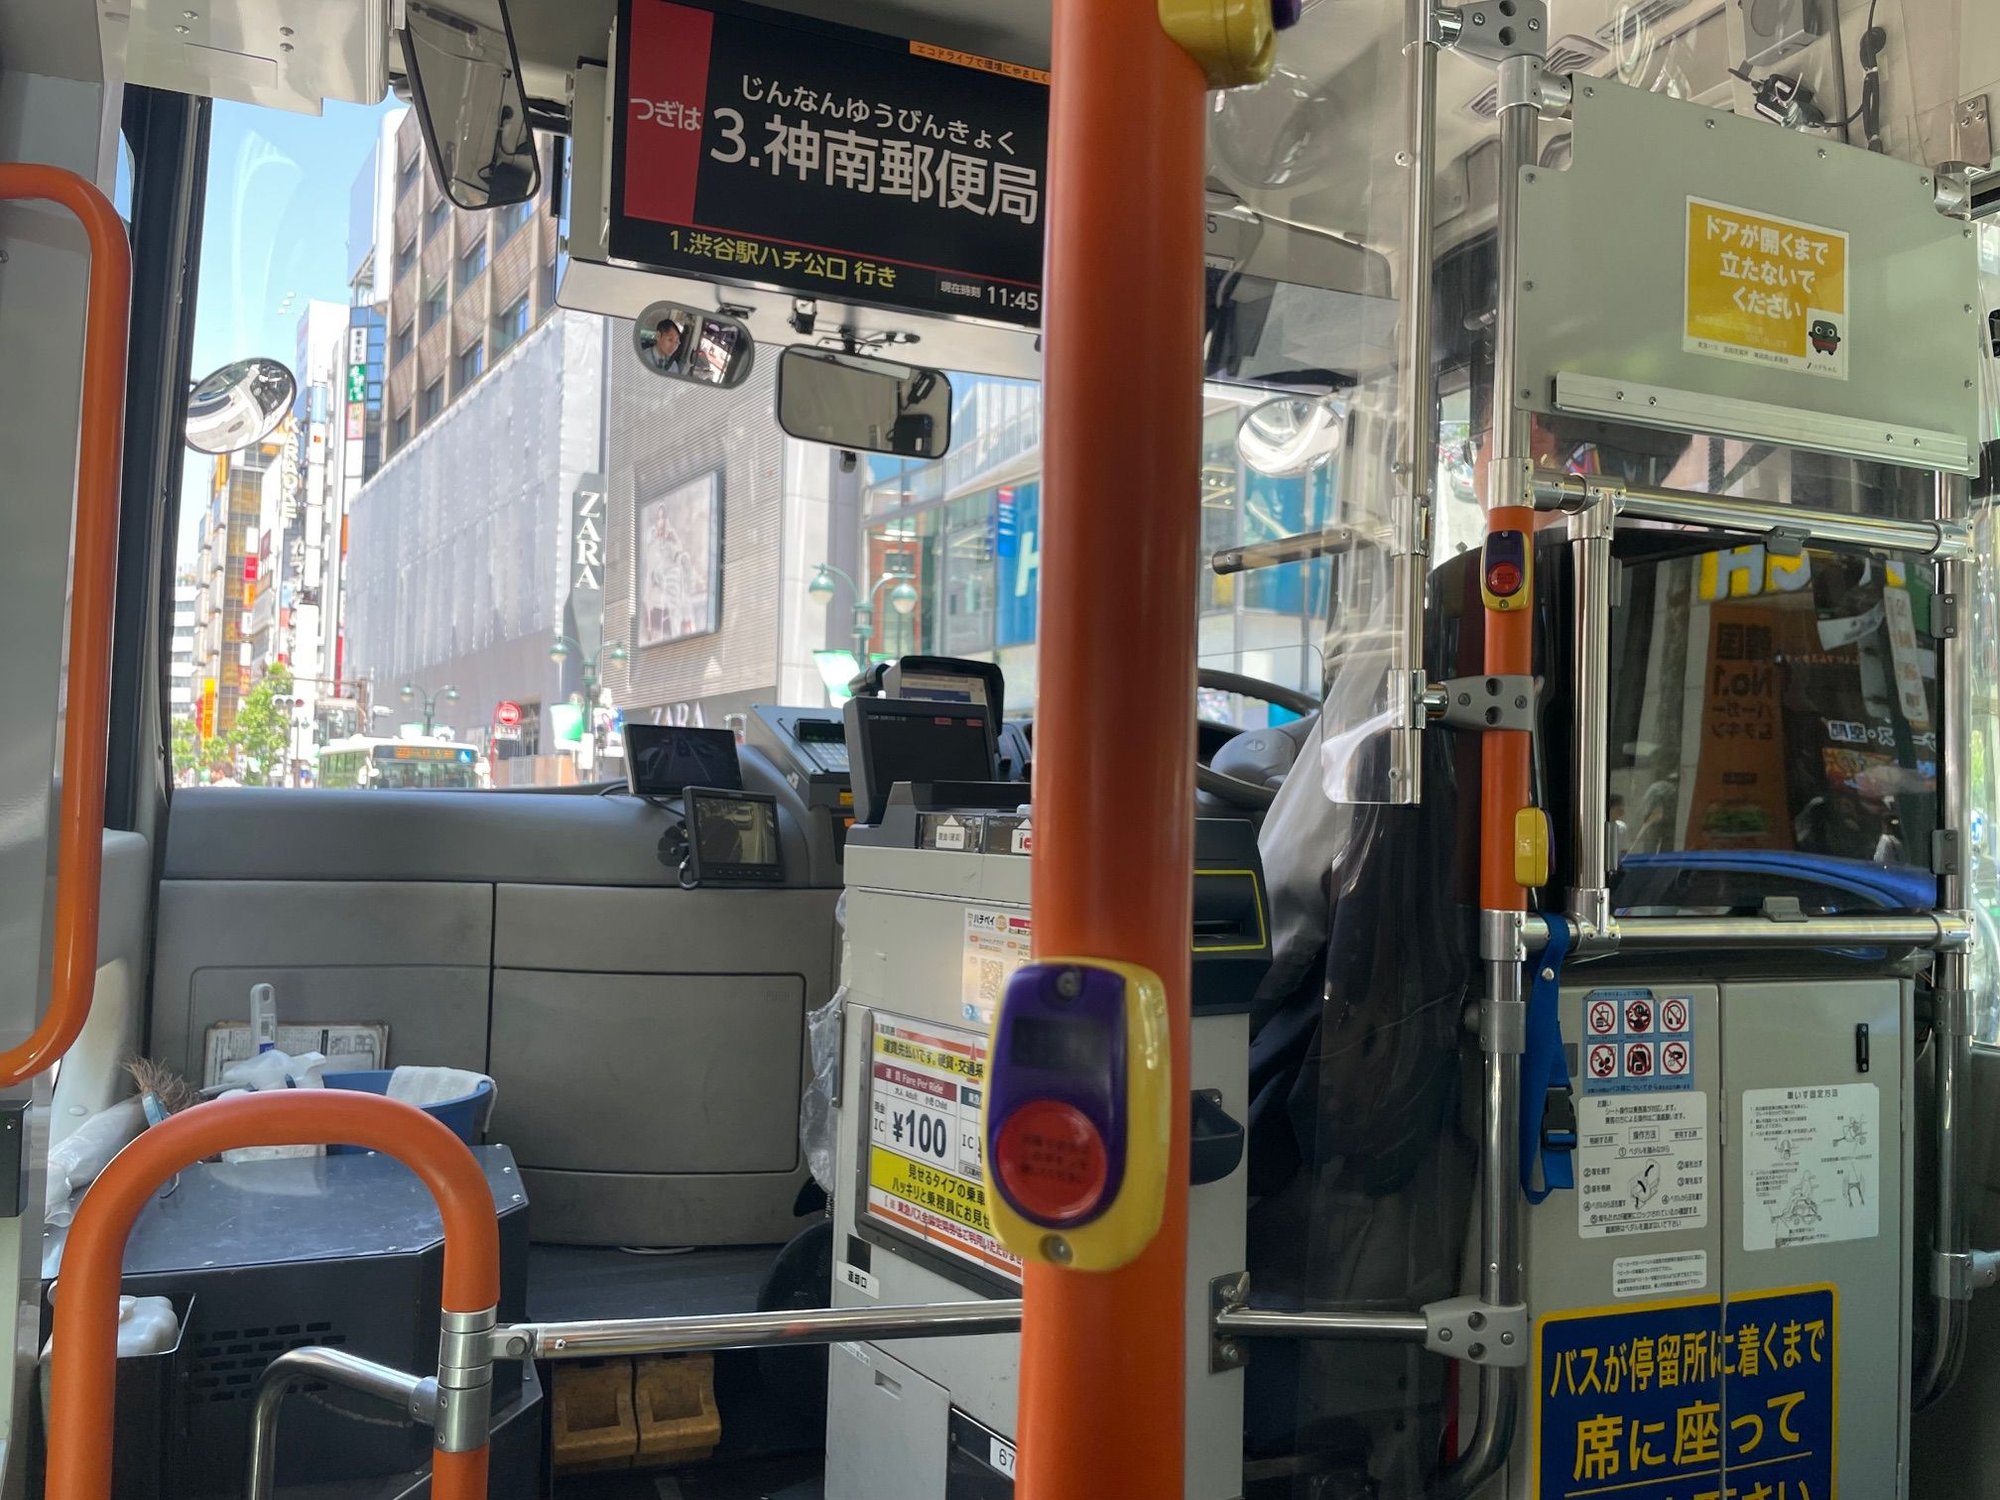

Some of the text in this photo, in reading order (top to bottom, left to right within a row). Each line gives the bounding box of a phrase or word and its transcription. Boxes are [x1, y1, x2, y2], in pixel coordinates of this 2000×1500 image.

[629, 97, 701, 132] つぎは
[741, 74, 1016, 155] じんなんゆうびんきょく
[710, 107, 1040, 225] 3.神南郵便局
[669, 230, 897, 289] 1.渋谷駅ハチ公口 行き
[1706, 214, 1829, 266] ドアが開くまで
[987, 285, 1039, 311] 11:45
[1719, 250, 1816, 295] 立たないで
[1732, 285, 1801, 320] ください
[574, 490, 602, 591] ZARA
[873, 1117, 885, 1132] IC
[892, 1109, 948, 1159] ¥100
[962, 1134, 975, 1150] IC
[1550, 1318, 1826, 1399] バスが停留所に着くまで
[1572, 1390, 1806, 1482] 席に座って
